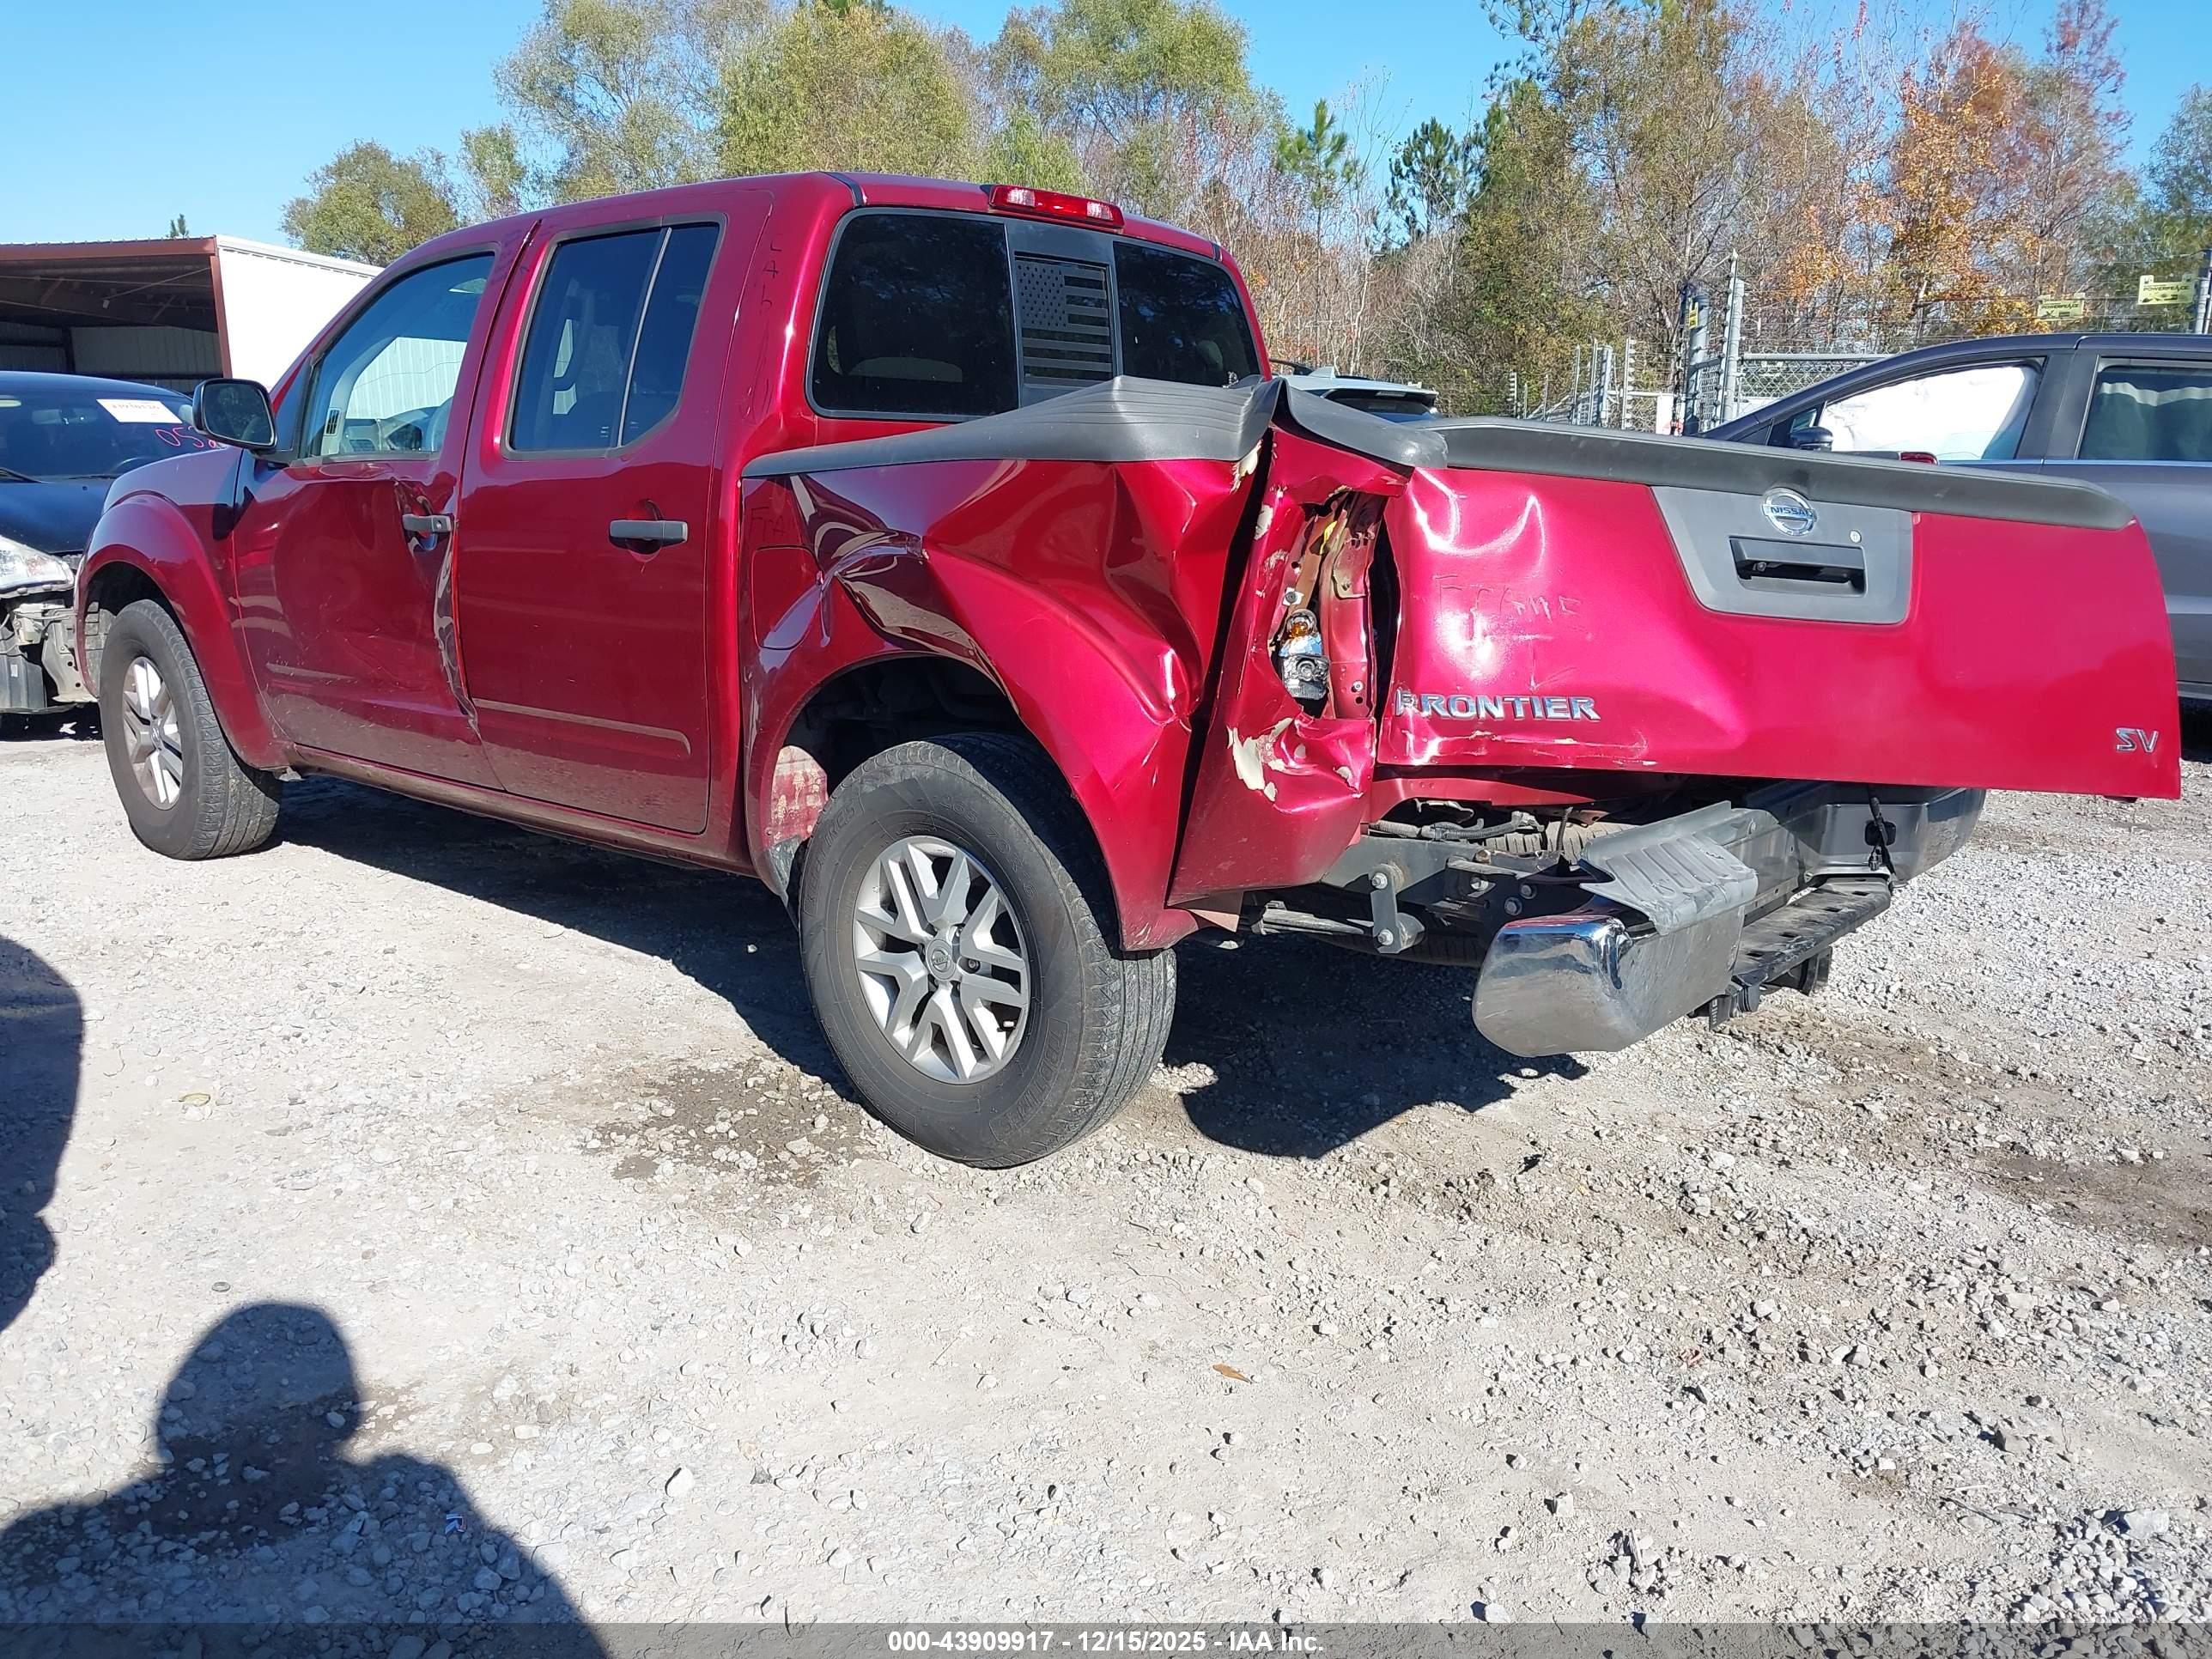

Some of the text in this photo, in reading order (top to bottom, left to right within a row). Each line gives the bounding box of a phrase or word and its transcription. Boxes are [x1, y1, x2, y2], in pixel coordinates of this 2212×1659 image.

[1771, 507, 1813, 518] NISSAN
[1395, 686, 1601, 721] FRONTIER
[2116, 727, 2159, 753] SV
